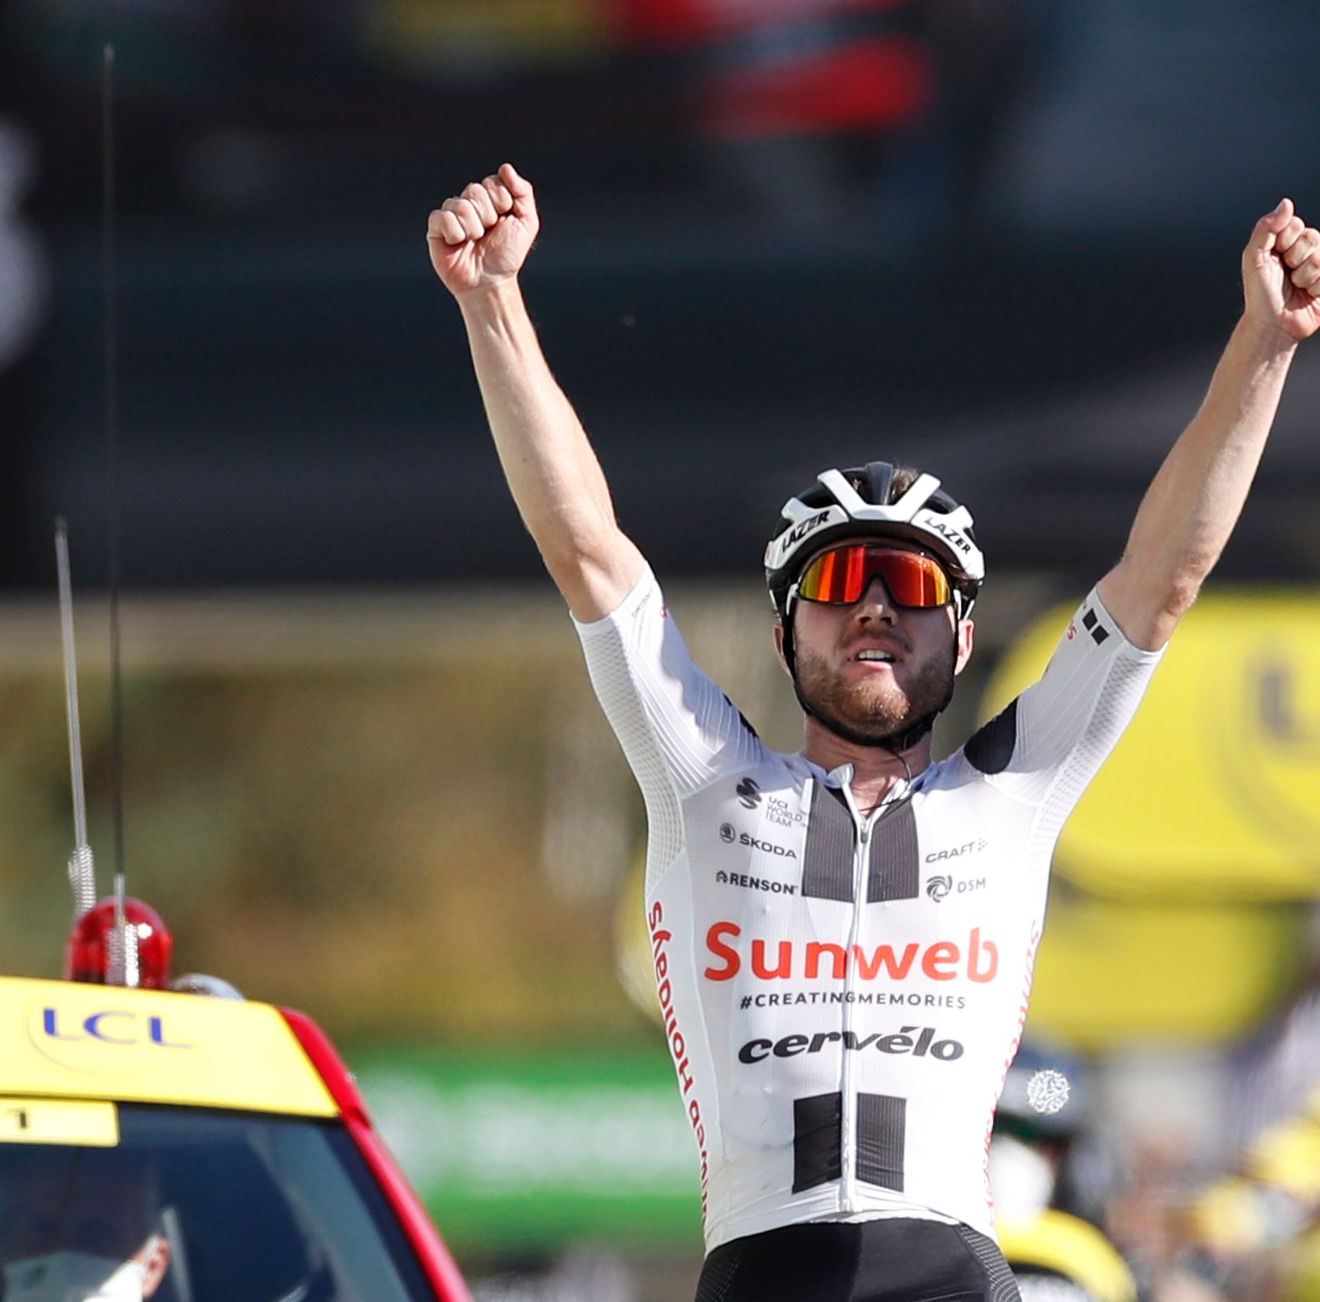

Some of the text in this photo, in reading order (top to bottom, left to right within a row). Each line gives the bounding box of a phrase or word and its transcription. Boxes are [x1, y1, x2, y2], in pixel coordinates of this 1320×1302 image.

[782, 510, 830, 551] LAZER
[925, 516, 972, 554] LAZER
[768, 796, 789, 809] UCI
[765, 812, 792, 829] TEAM
[767, 806, 804, 823] WORLD
[739, 833, 798, 860] ŠKODA
[925, 841, 977, 864] CRAFT
[730, 873, 795, 895] RENSON
[957, 878, 987, 894] DSM
[704, 921, 999, 984] Sunweb
[740, 990, 966, 1010] #CREATINGMEMORIES
[42, 1007, 193, 1049] LCL
[737, 1026, 965, 1065] cervélo
